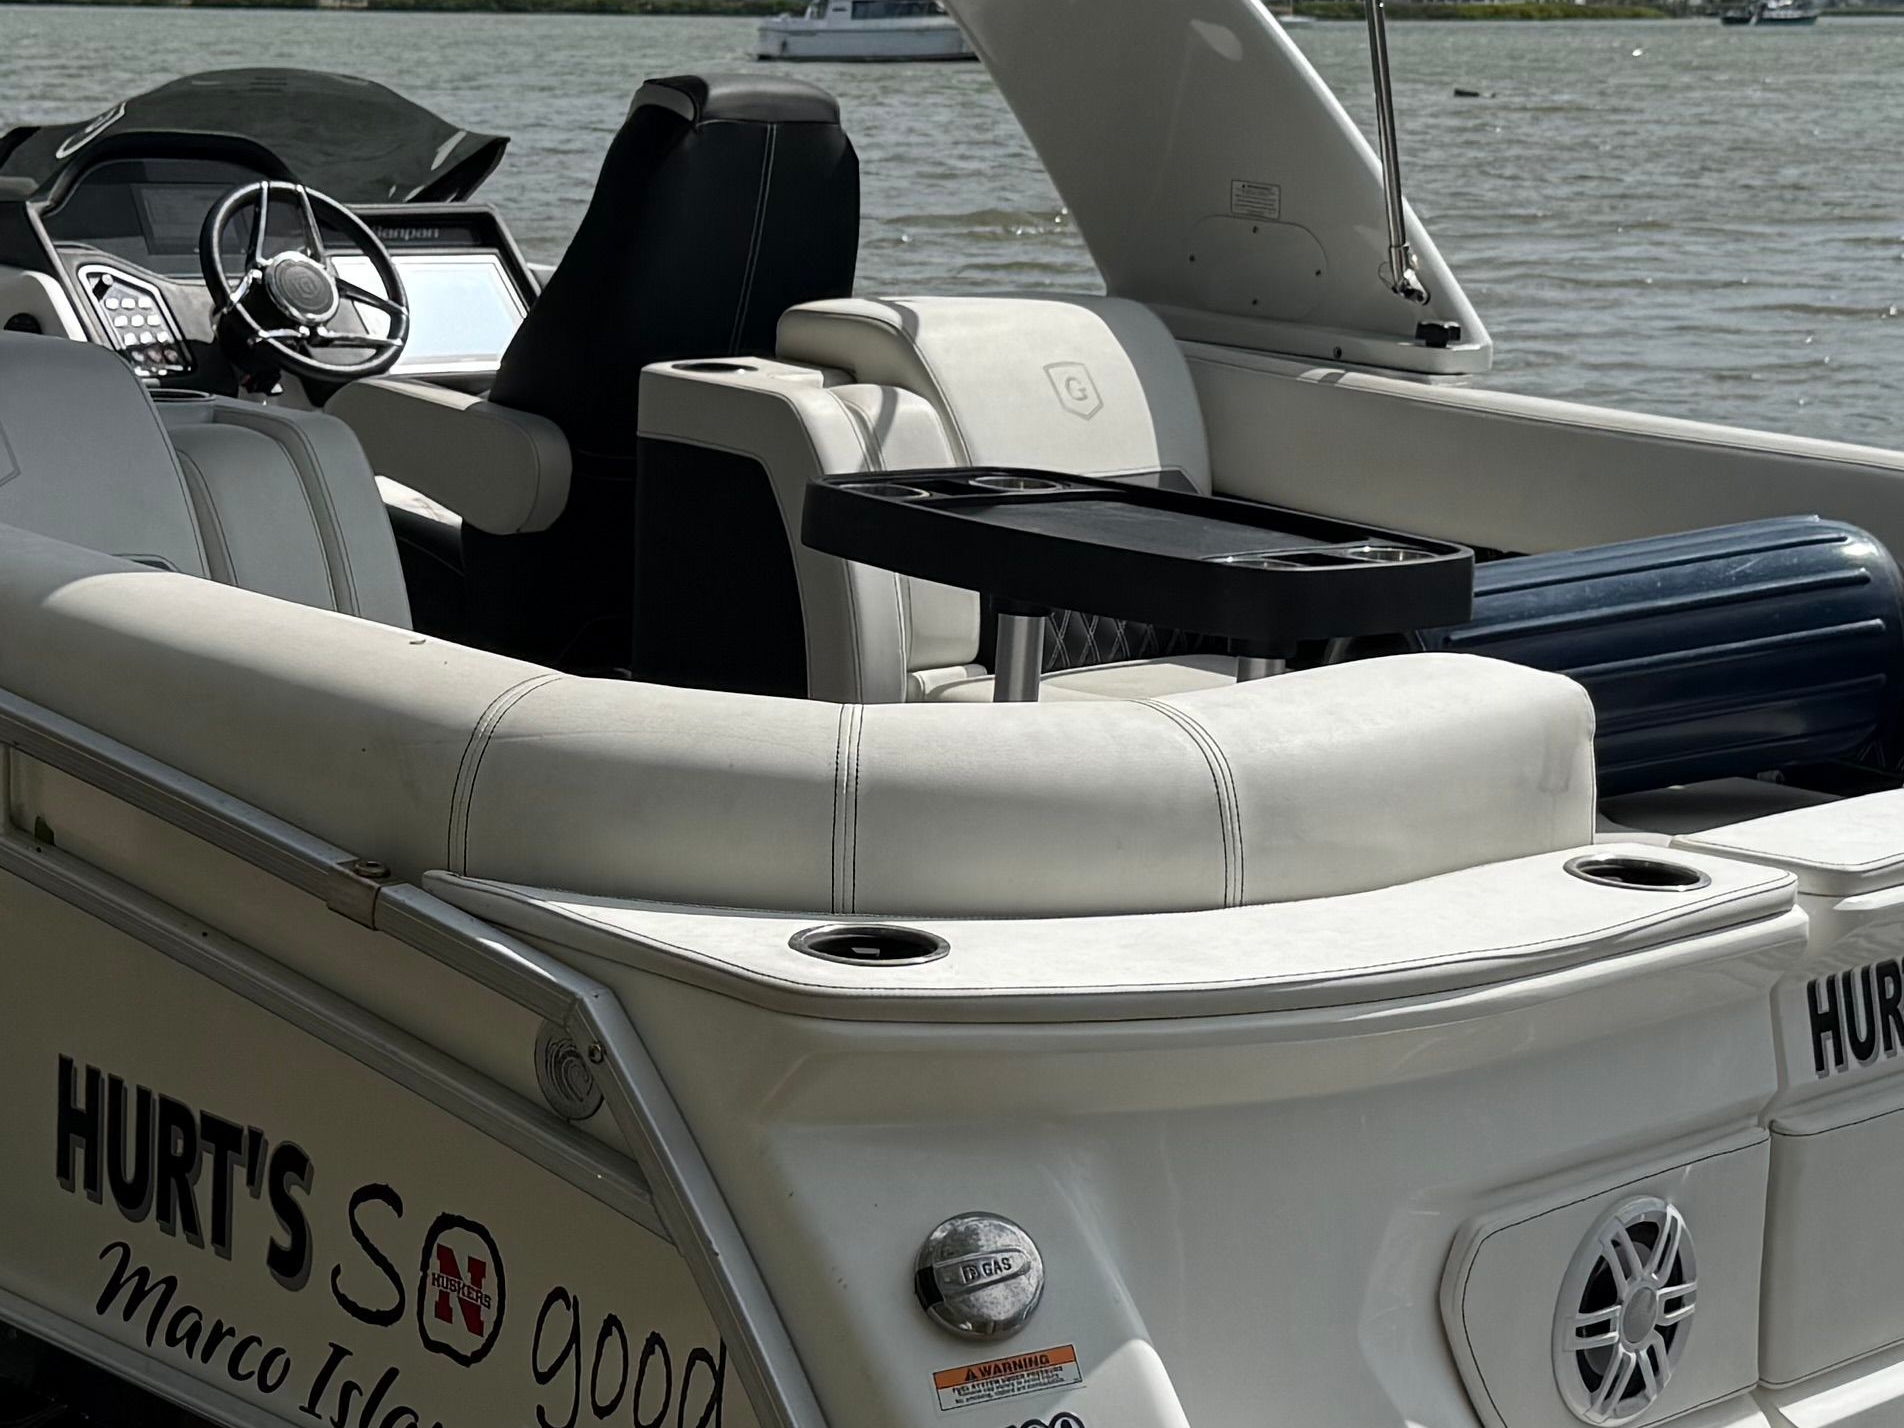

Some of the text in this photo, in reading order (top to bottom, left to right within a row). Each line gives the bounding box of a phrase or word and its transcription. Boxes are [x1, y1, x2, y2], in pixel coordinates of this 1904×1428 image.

[55, 1053, 314, 1291] HURT'S
[982, 1257, 1012, 1277] GAS
[432, 1272, 492, 1310] HUSKERS
[97, 1241, 292, 1394] Marco
[979, 1354, 1050, 1378] WARNING
